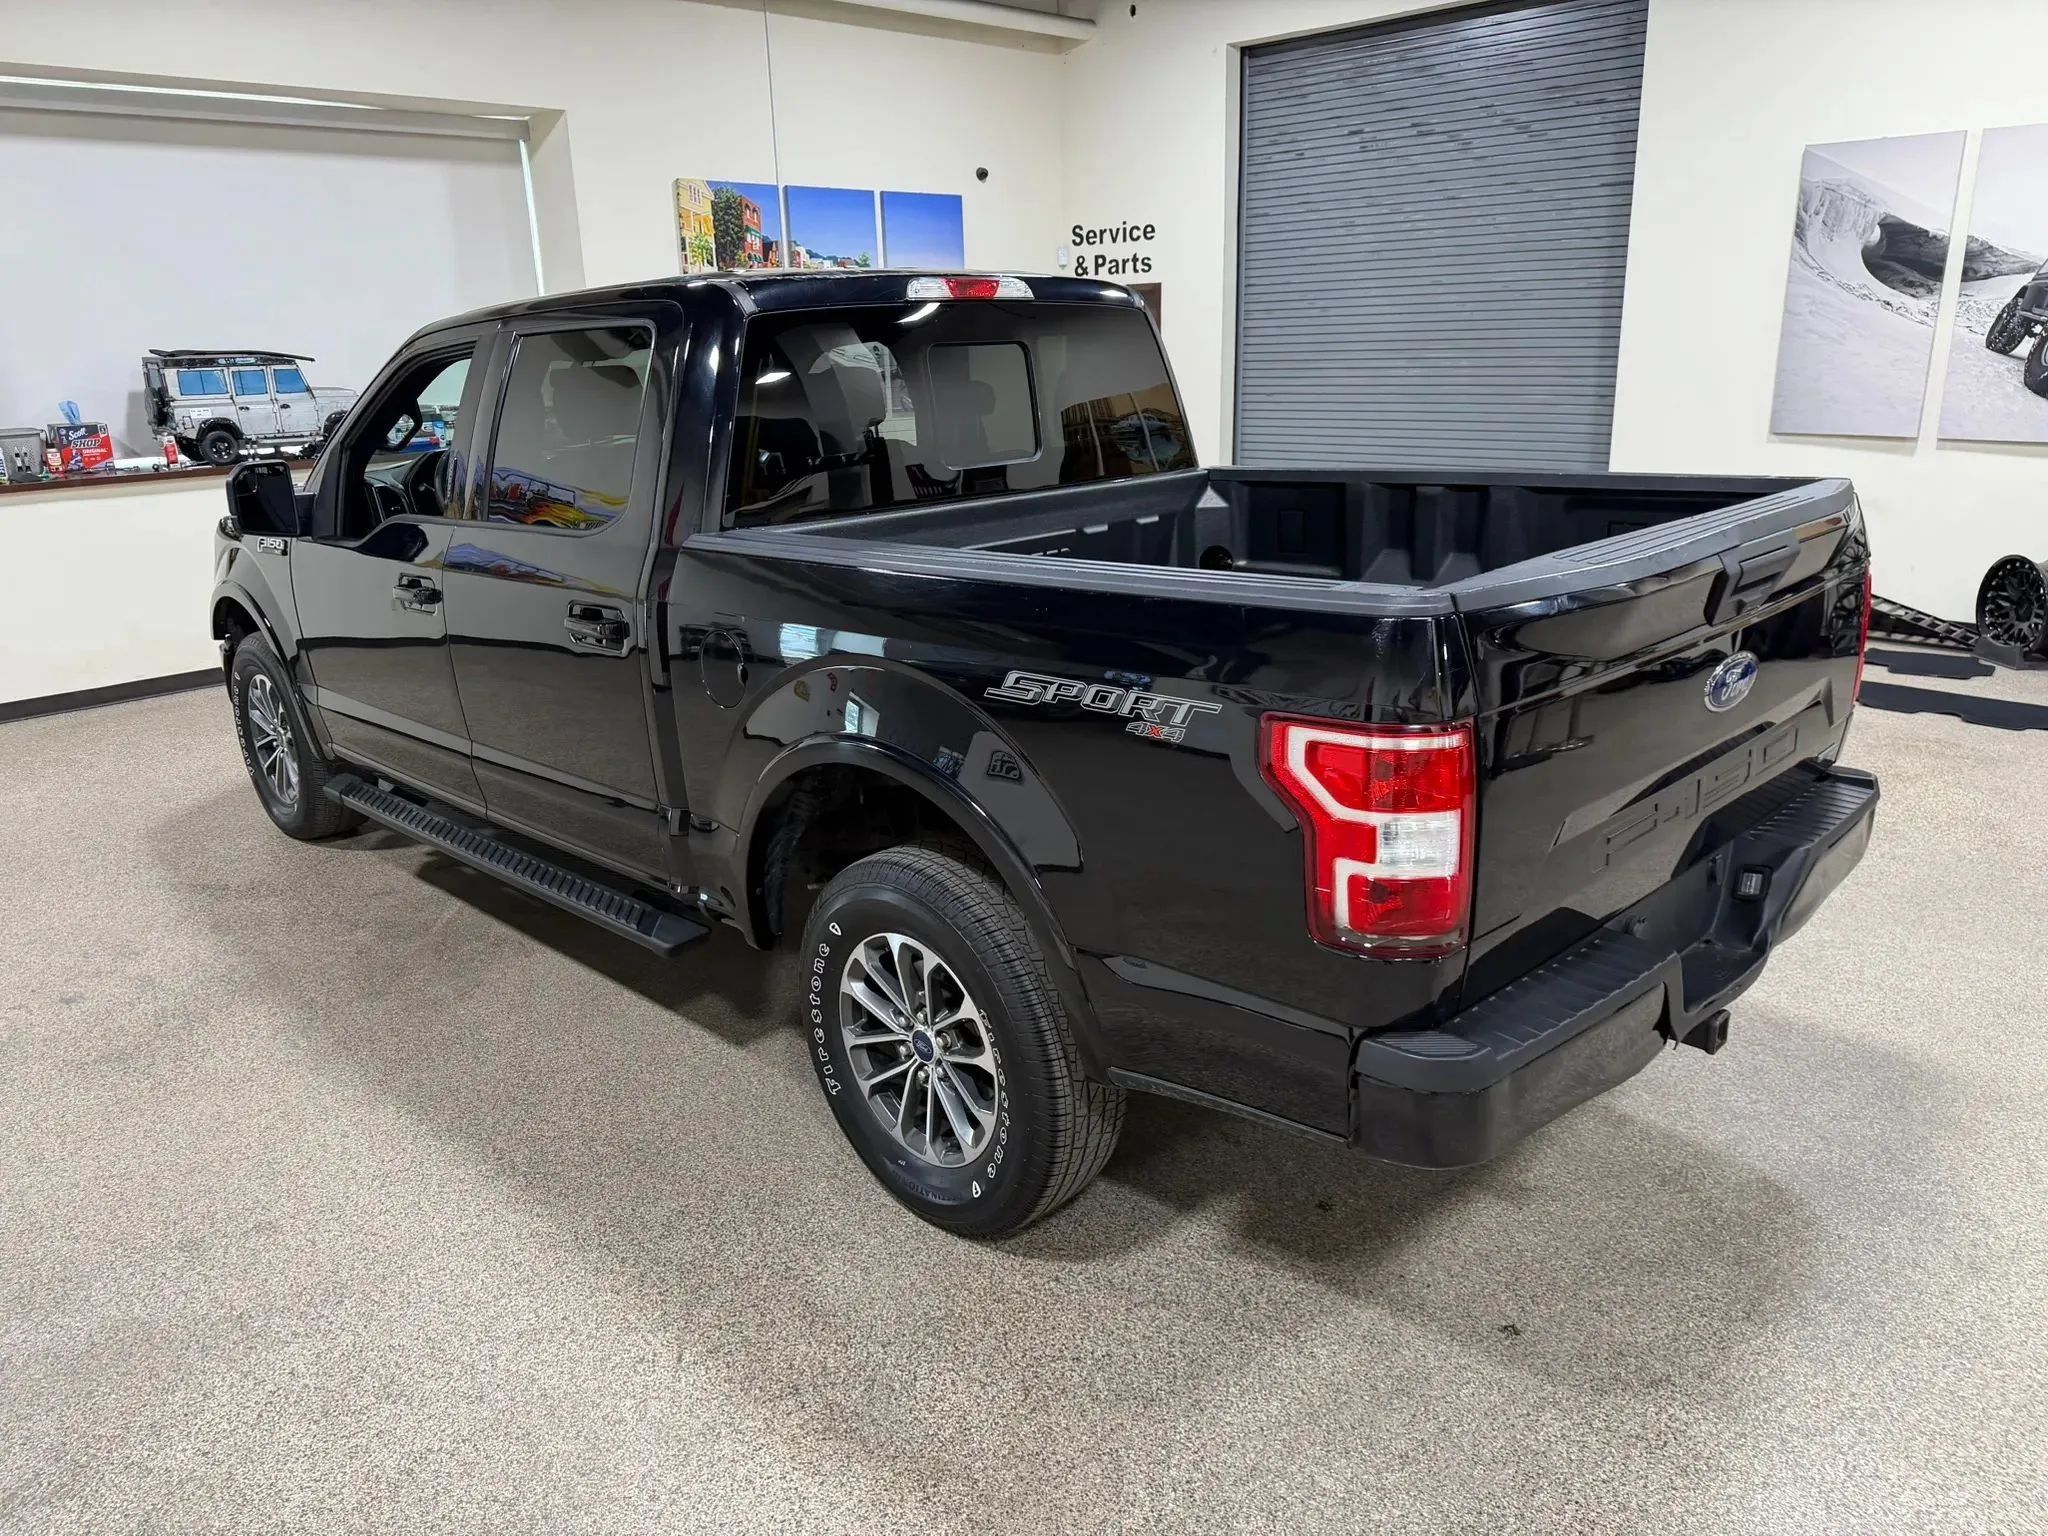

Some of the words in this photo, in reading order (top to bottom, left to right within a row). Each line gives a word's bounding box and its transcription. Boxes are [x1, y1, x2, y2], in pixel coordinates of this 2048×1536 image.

[1072, 221, 1156, 246] Service
[1074, 255, 1089, 277] &
[1094, 252, 1153, 276] Parts
[71, 438, 102, 449] SHOP
[984, 669, 1223, 727] SPORT
[809, 943, 842, 1096] Firestone
